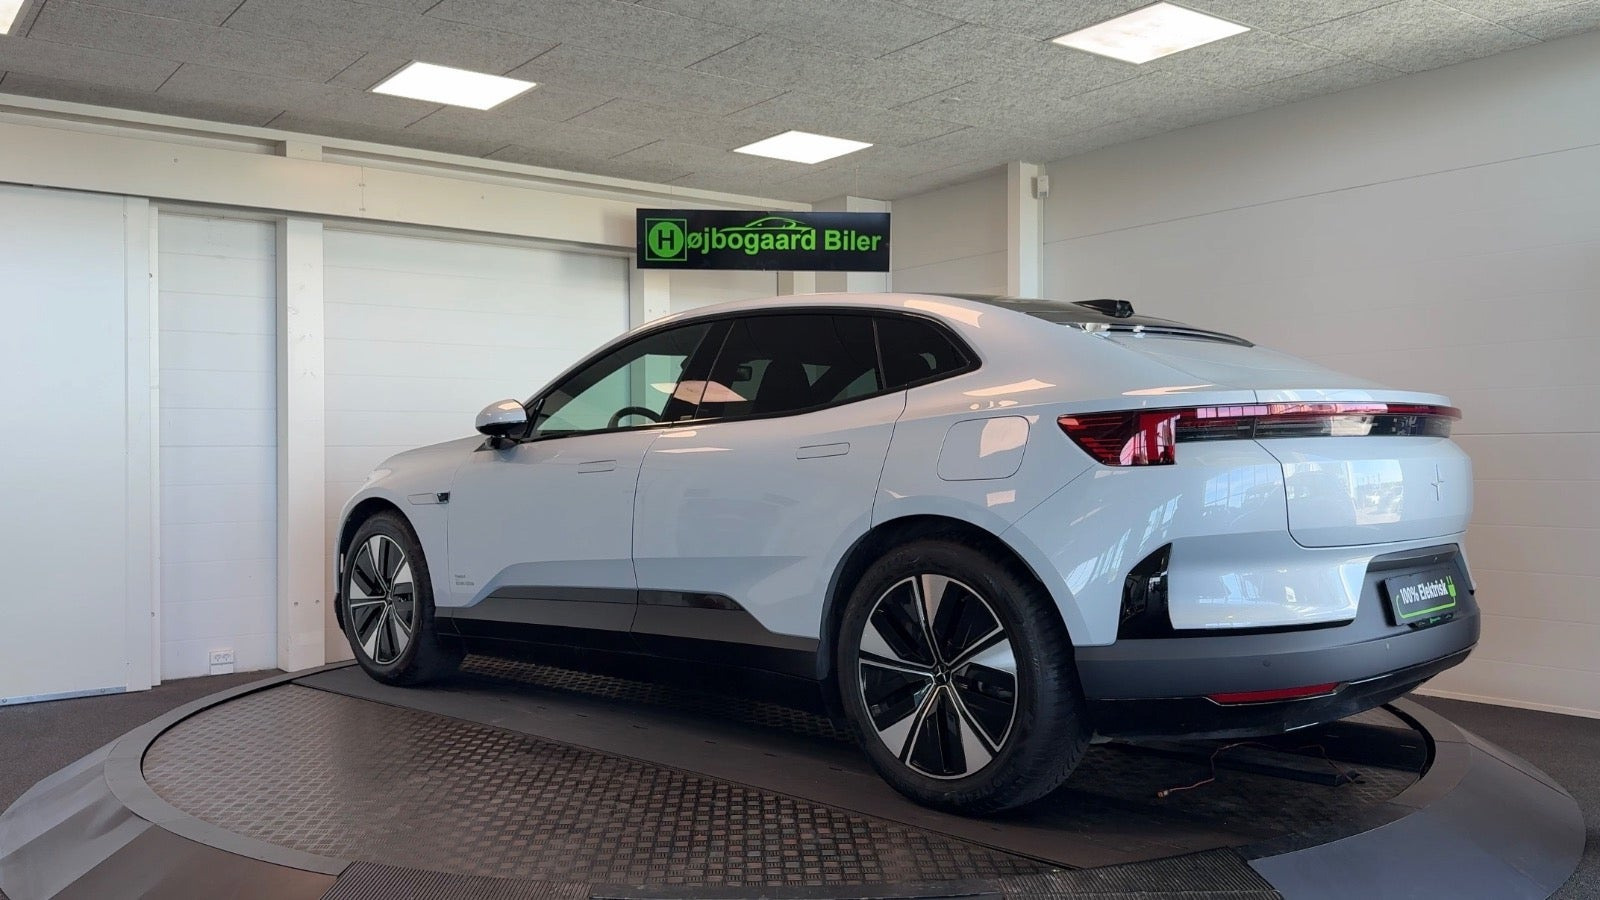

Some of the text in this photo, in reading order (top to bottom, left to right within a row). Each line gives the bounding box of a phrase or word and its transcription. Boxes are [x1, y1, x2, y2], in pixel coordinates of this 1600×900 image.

[823, 229, 882, 252] Biler
[1400, 579, 1448, 604] 100% Elektrisk
